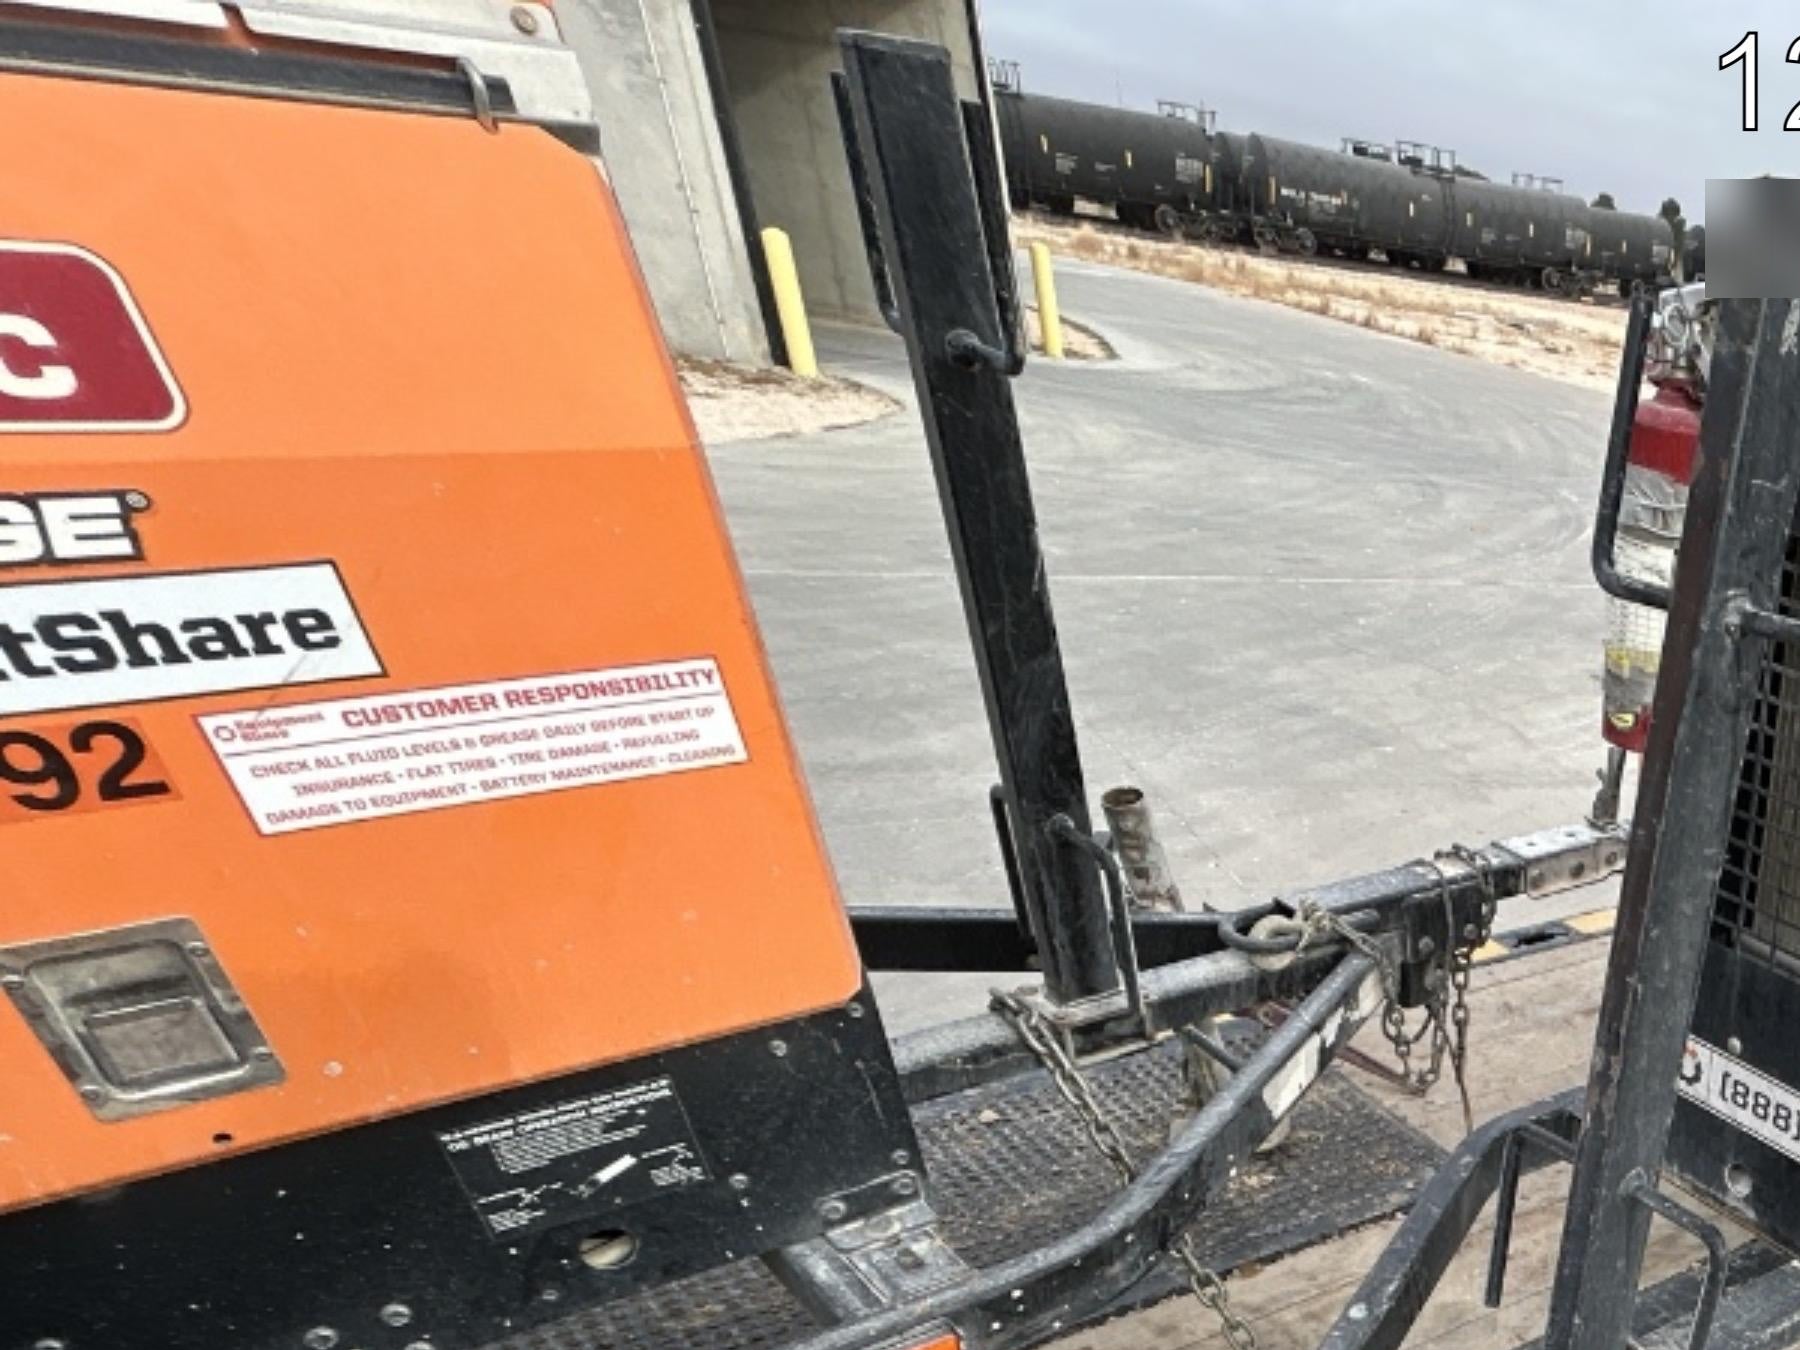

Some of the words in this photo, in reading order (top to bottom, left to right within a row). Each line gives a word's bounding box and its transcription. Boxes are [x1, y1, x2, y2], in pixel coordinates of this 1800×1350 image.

[0, 608, 342, 681] tShare
[341, 691, 499, 728] CUSTOMER
[503, 668, 715, 709] RESPONSIBILITY
[0, 720, 171, 812] 92
[249, 757, 310, 779] CHECK
